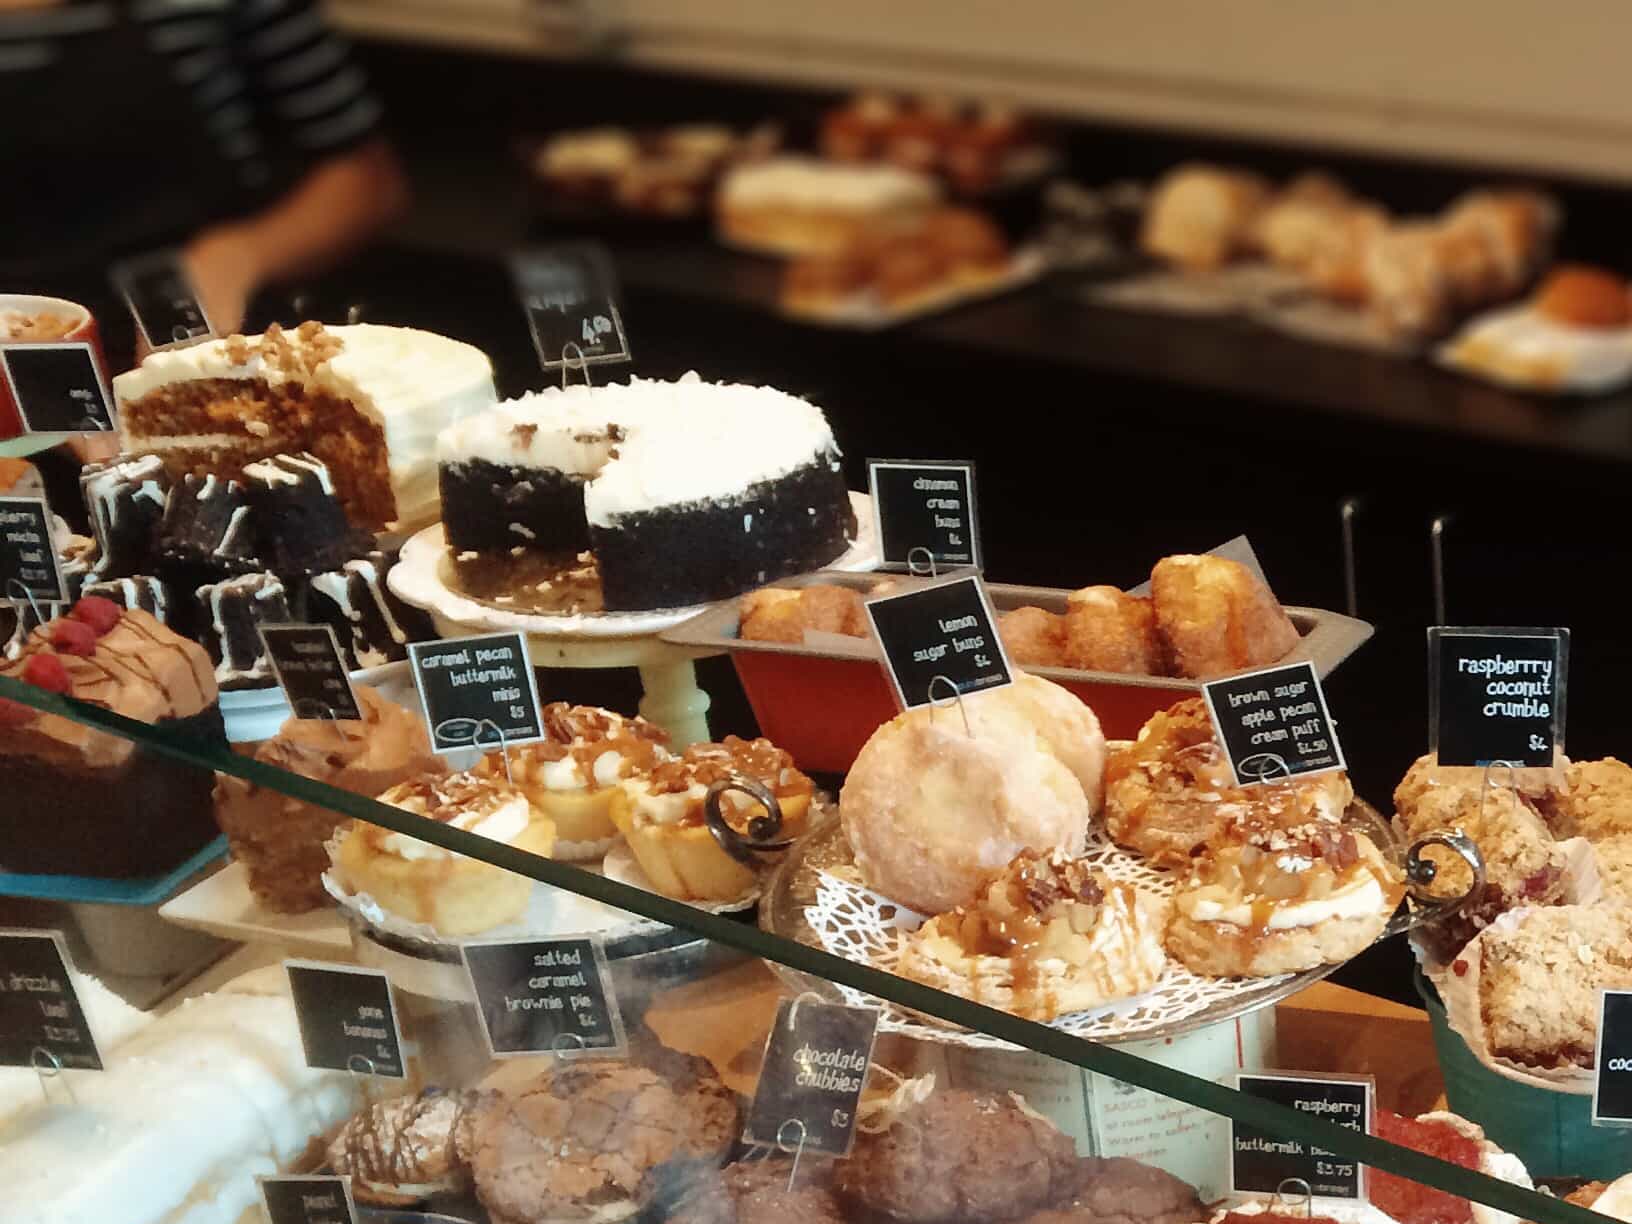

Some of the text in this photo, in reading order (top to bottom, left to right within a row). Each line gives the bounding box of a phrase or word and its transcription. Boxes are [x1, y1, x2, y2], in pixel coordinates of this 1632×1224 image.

[938, 614, 979, 633] lemon
[421, 646, 513, 669] caramel pecan
[913, 643, 949, 662] sugar
[449, 665, 517, 687] buttermilk
[492, 687, 521, 702] minis
[1228, 681, 1309, 708] brown sugar
[1486, 677, 1552, 697] coconut
[1241, 701, 1317, 729] apple pecan
[1483, 698, 1551, 718] crumble
[1251, 718, 1321, 745] cream puff
[534, 948, 582, 967] salted
[528, 971, 587, 989] caramel
[504, 993, 592, 1012] brownie pie
[793, 1042, 866, 1072] chocolate
[795, 1068, 861, 1093] chubbies
[1293, 1097, 1361, 1117] raspberry
[831, 1108, 849, 1128] $3
[1234, 1136, 1304, 1155] buttermilk
[1316, 1161, 1353, 1177] $3.75
